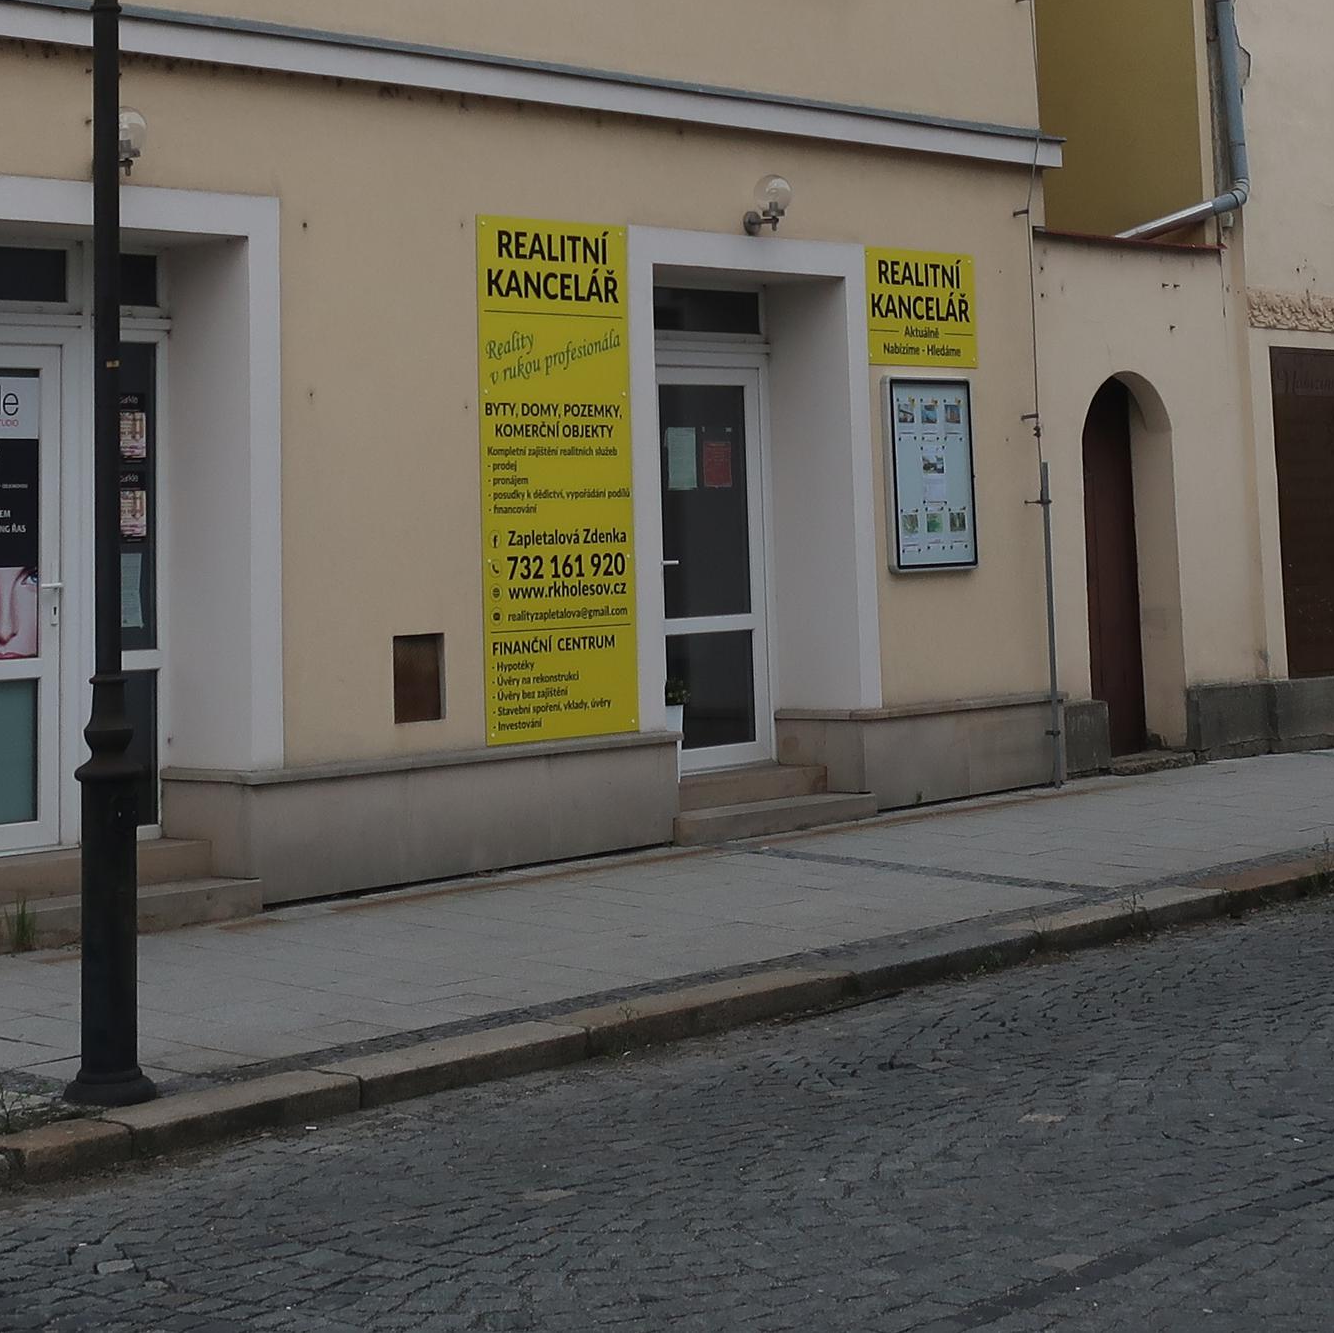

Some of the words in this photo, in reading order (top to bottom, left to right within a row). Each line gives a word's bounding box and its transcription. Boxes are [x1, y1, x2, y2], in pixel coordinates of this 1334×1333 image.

[497, 230, 609, 265] REALITNÍ
[878, 259, 961, 290] REALITNÍ
[487, 268, 619, 303] KANCELÁŘ
[871, 293, 970, 323] KANCELÁŘ
[904, 325, 940, 339] Aktuálně
[485, 330, 534, 360] Reality
[883, 342, 920, 356] Nabízíme
[927, 344, 961, 357] Hledáme
[490, 371, 500, 385] v
[503, 356, 541, 384] rukou
[544, 328, 621, 375] profesionála
[485, 402, 518, 418] BYTY,
[521, 403, 561, 419] DOMY,
[563, 404, 622, 419] POZEMKY,
[495, 421, 560, 438] KOMERČNÍ
[562, 424, 614, 438] OBJEKTY
[560, 446, 593, 456] realitních
[492, 461, 517, 472] prodej
[493, 476, 528, 487] pronájem
[493, 490, 525, 501] posudky
[493, 504, 537, 514] financování
[507, 529, 580, 547] Zapletalová
[583, 528, 626, 544] Zdenka
[507, 556, 544, 581] 732
[550, 555, 585, 579] 161
[591, 552, 626, 577] 920
[508, 579, 627, 600] www.rkholesov.cz
[507, 605, 628, 623] realityzapletalova@gmail.com
[492, 635, 553, 656] FINANČNÍ
[557, 634, 615, 652] CENTRUM
[496, 660, 534, 673] Hypotéky
[497, 673, 520, 687] Úvěry
[522, 676, 531, 685] na
[532, 671, 579, 684] rekonstrukci
[497, 688, 521, 702] Úvěry
[522, 689, 536, 700] bez
[497, 703, 531, 717] Stavební
[590, 697, 612, 711] úvěry
[497, 717, 542, 732] Investování
